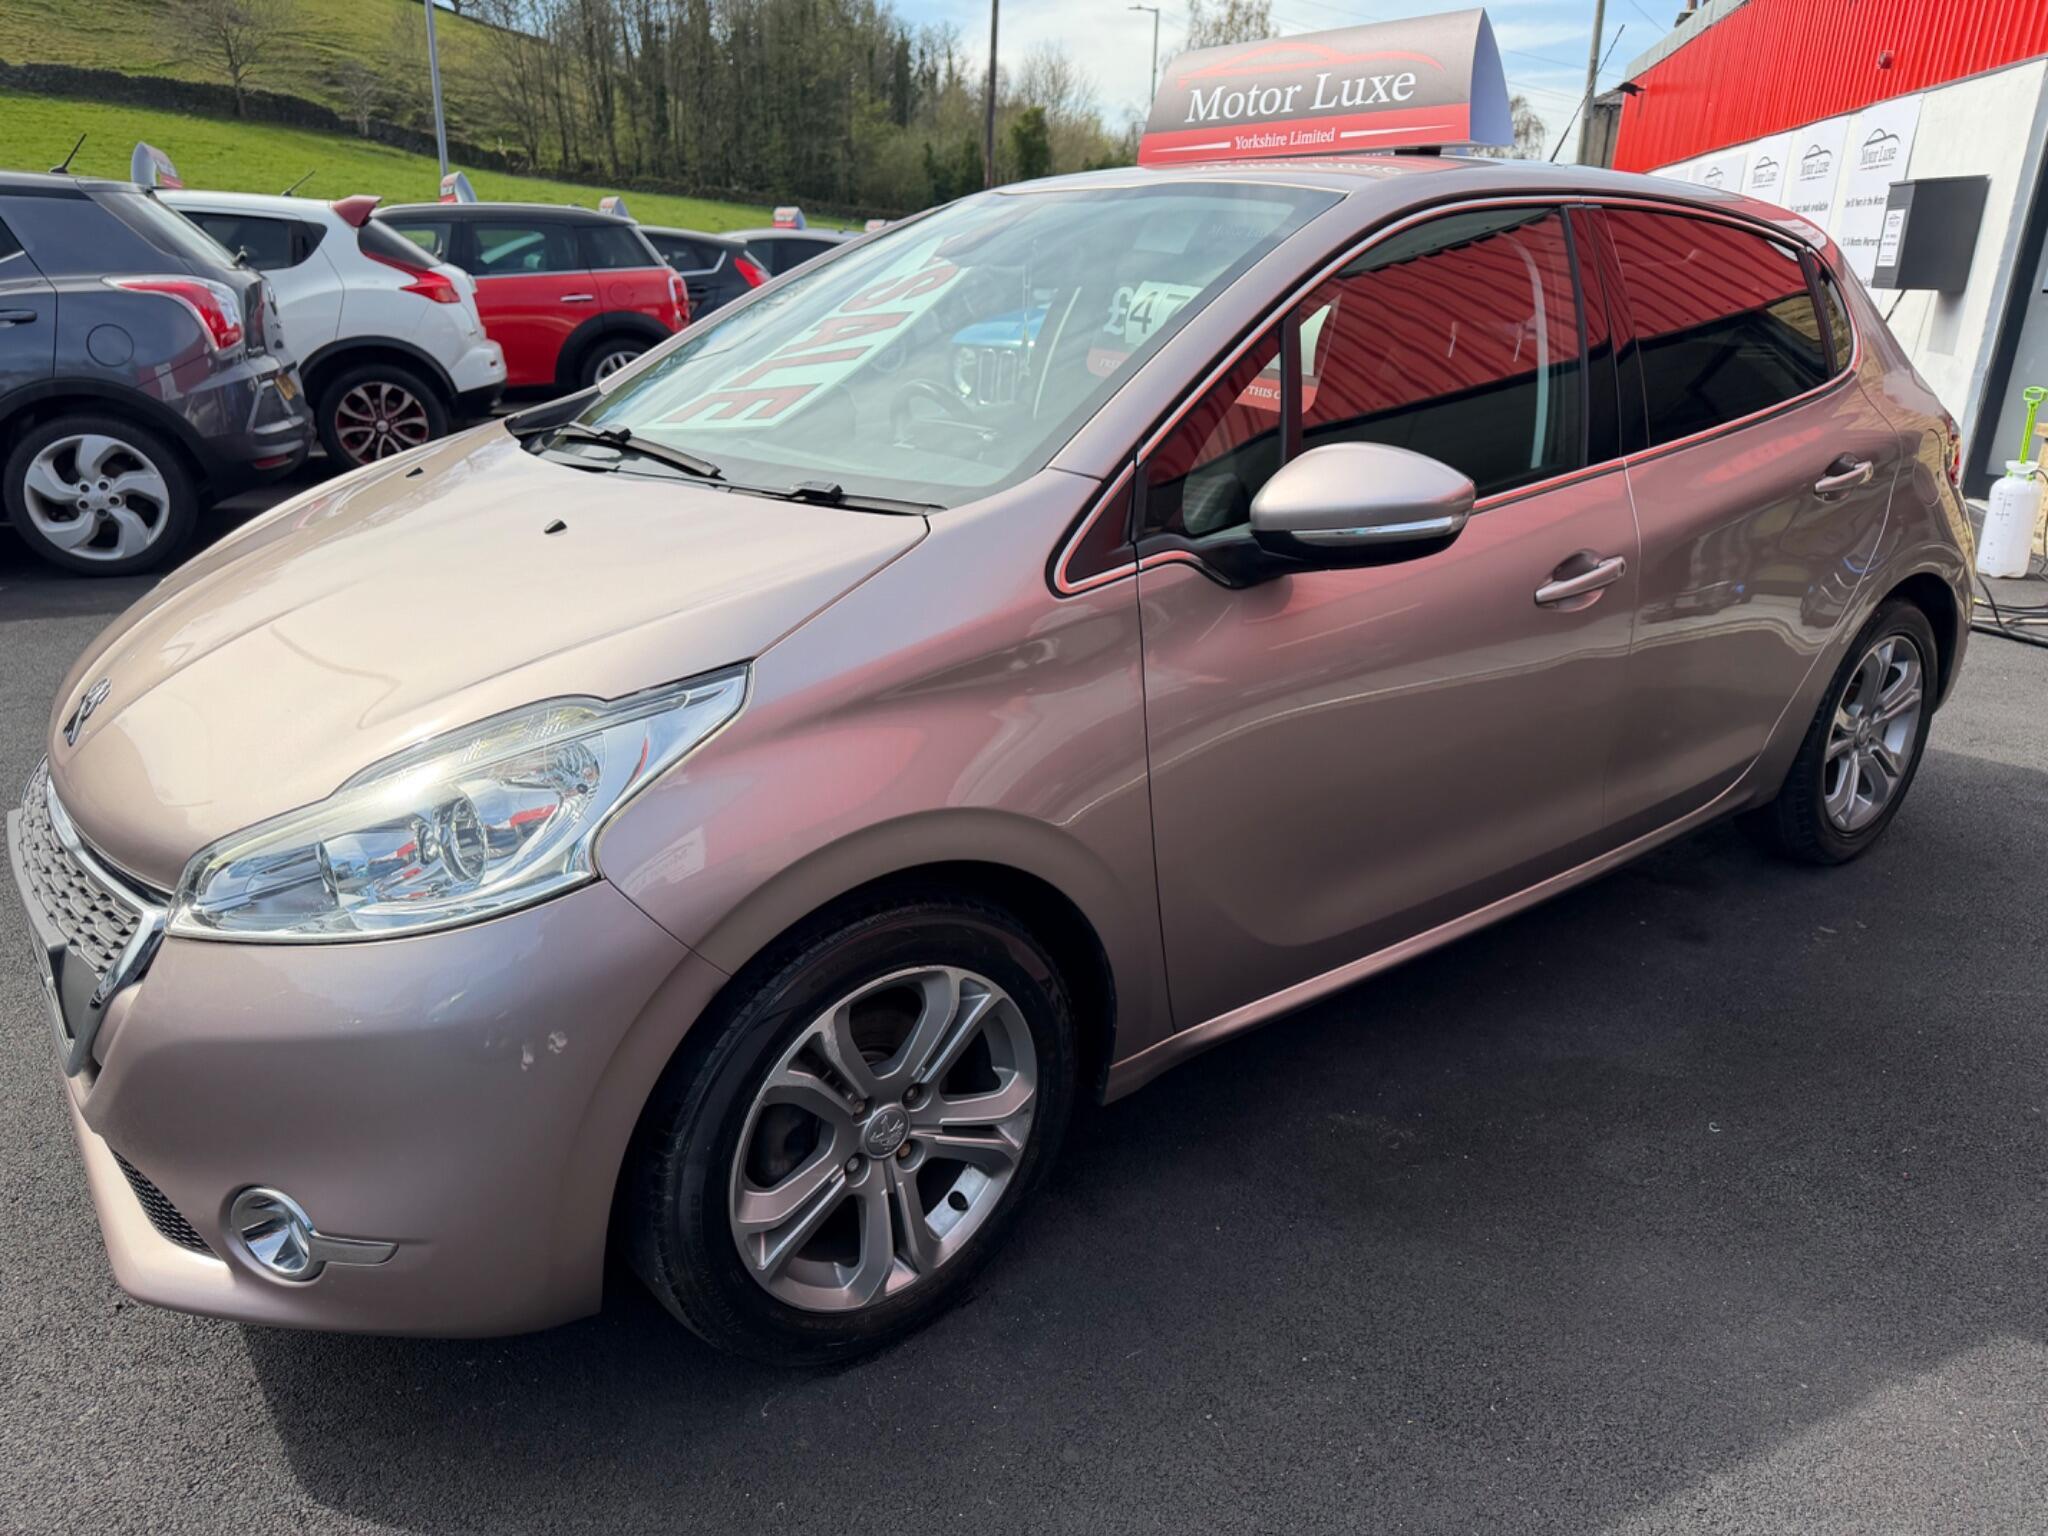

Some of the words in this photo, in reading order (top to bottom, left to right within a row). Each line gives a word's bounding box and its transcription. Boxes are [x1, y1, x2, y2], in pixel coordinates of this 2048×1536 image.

[1184, 83, 1302, 123] Motor
[1310, 72, 1417, 110] Luxe
[1234, 131, 1287, 150] Yorkshire
[1289, 128, 1336, 145] Limited
[656, 261, 960, 424] SALE
